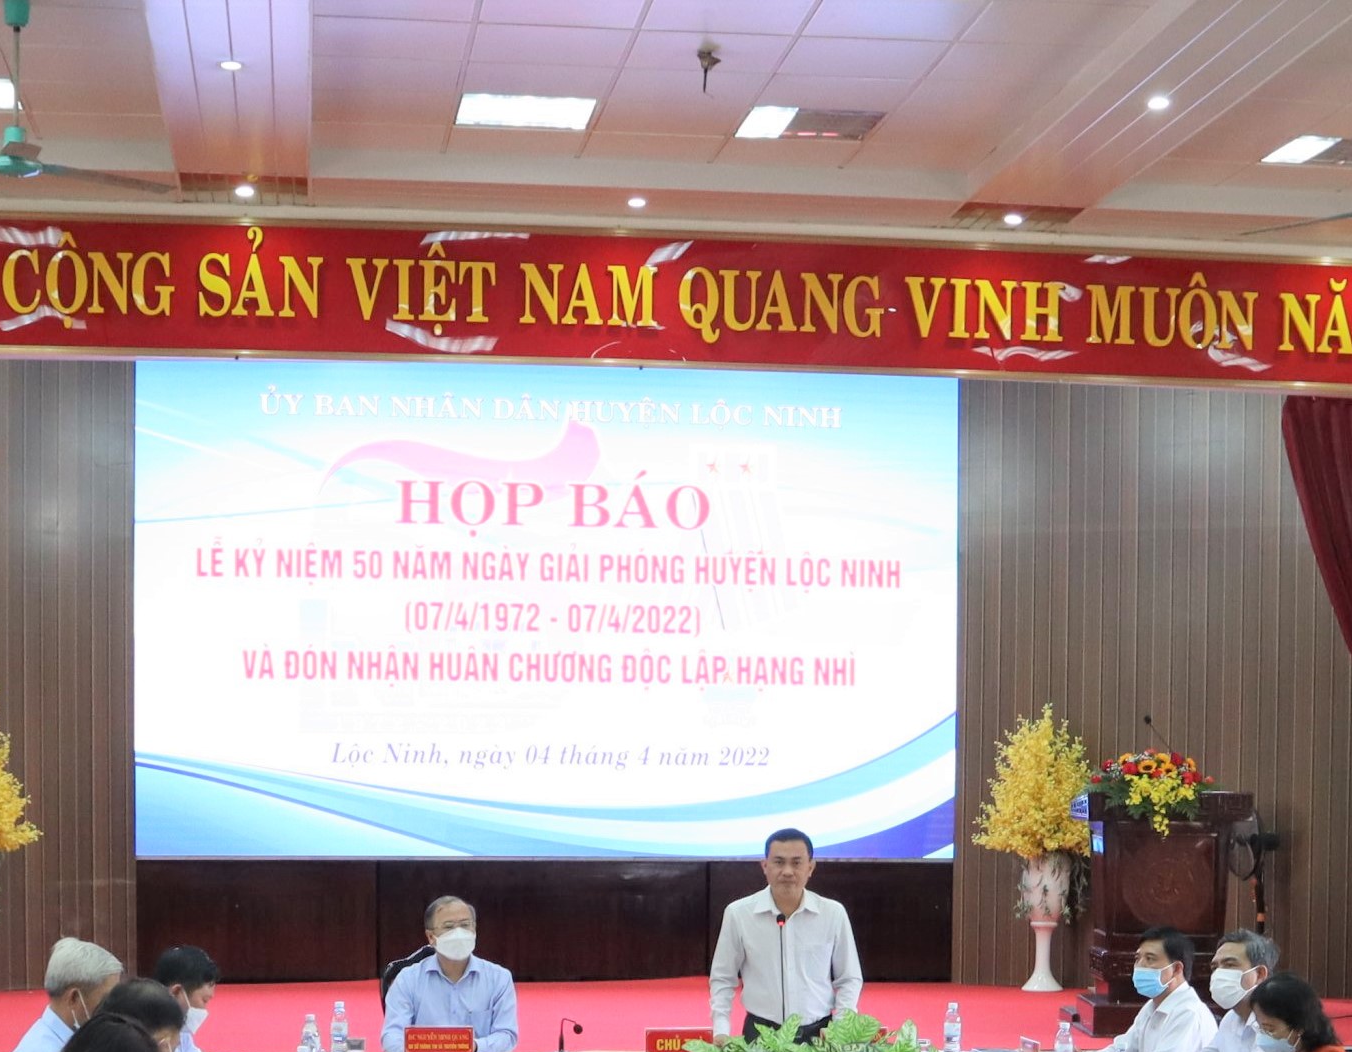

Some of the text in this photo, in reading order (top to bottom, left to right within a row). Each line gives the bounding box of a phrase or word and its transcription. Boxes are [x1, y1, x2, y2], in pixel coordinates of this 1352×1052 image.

[2, 231, 175, 329] CỘNG
[198, 226, 324, 319] SẢN
[346, 241, 497, 336] VIỆT
[519, 262, 658, 328] NAM
[678, 266, 884, 344] QUANG
[904, 276, 1064, 342] VINH
[1086, 271, 1258, 351] MUÔN
[259, 385, 842, 431] ỦY BAN NHÂN DÂN HUYỆN LỘC NINH
[396, 470, 711, 539] HỌP BÁO
[196, 536, 901, 593] LỄ KỶ NIỆM 50 NĂM NGÀY GIẢI PHÓNG HUYỆN LỘC NINH
[405, 601, 541, 633] (07/4/1972
[567, 603, 701, 637] 07/4/2022)
[242, 643, 856, 692] VÀ ĐÓN NHẬN HUÂN CHƯƠNG ĐỘC LẬP HẠNG NHÌ
[331, 742, 770, 770] Lộc Ninh, ngày 04 tháng 4 năm 2022
[656, 1034, 681, 1051] CHỦ
